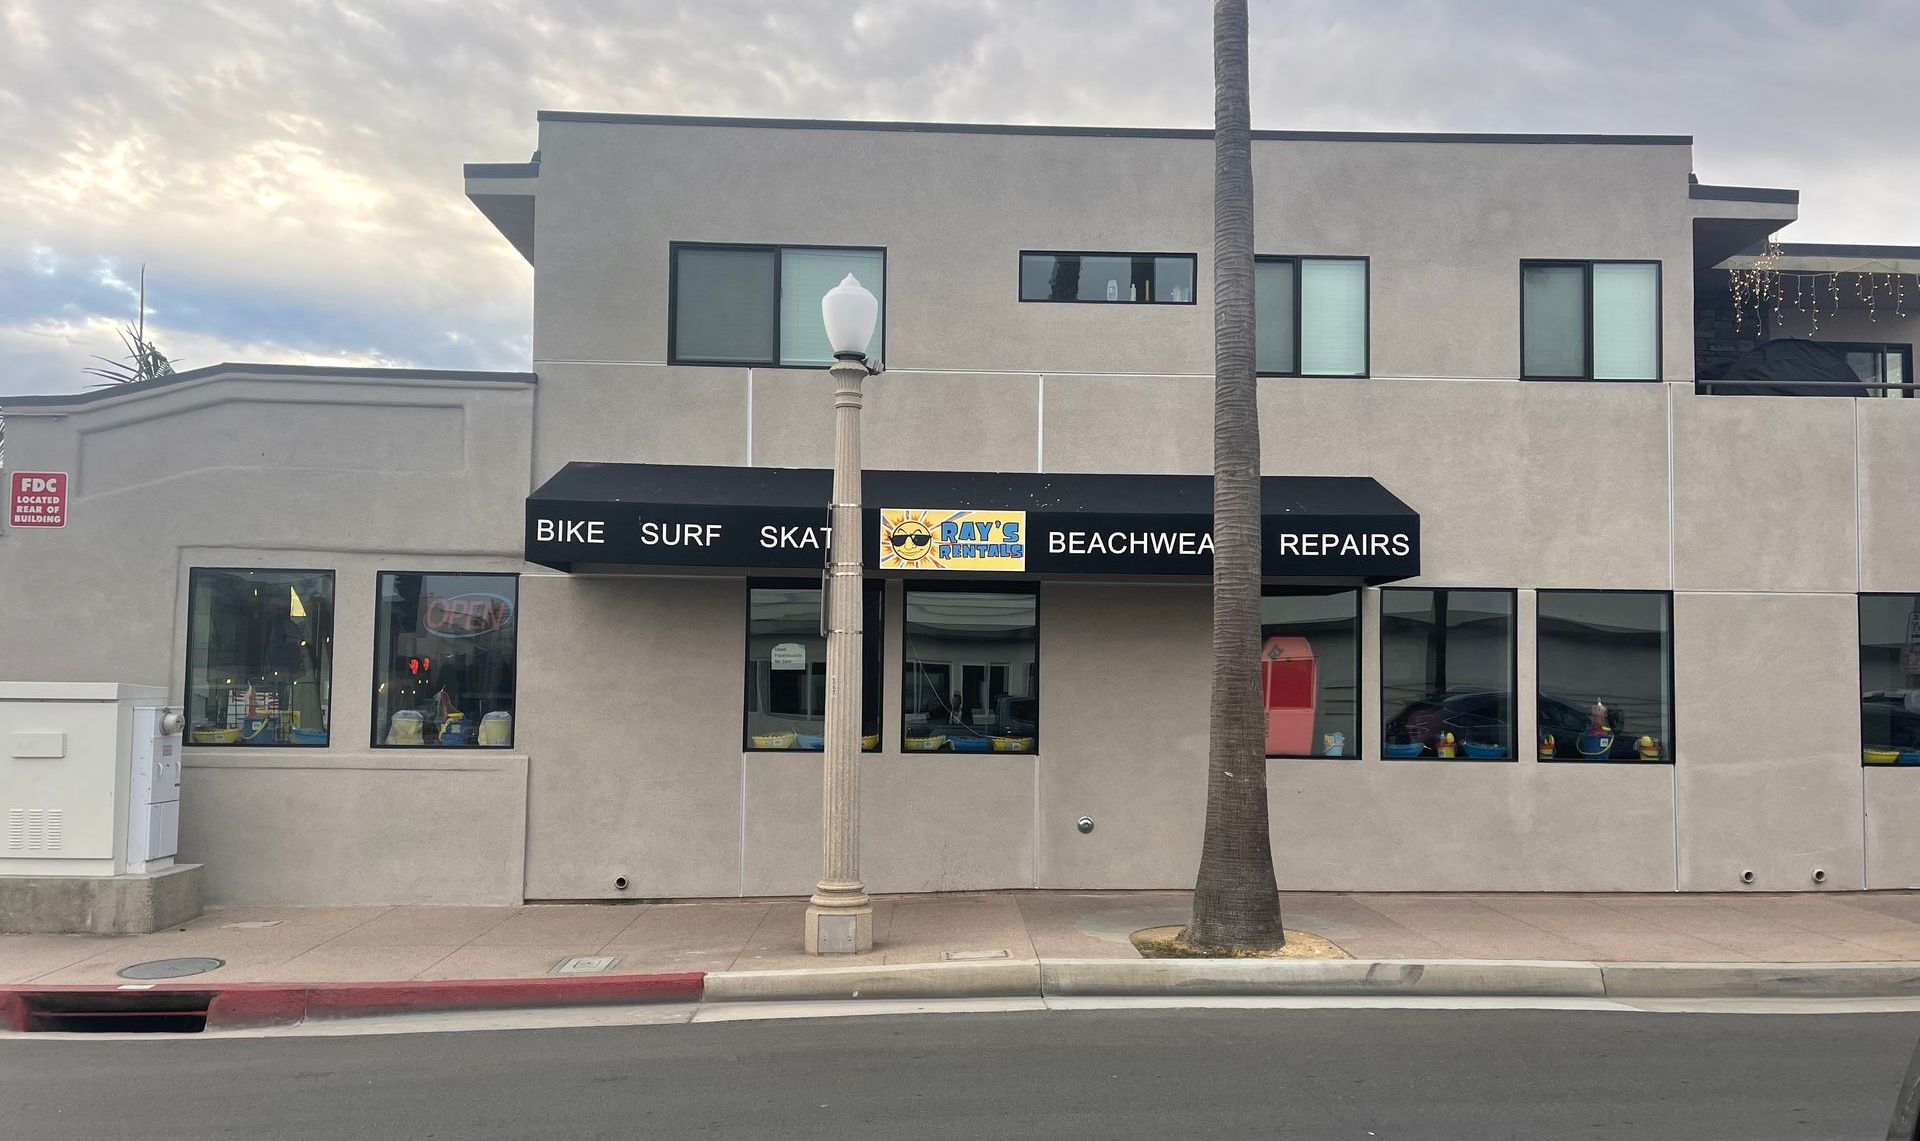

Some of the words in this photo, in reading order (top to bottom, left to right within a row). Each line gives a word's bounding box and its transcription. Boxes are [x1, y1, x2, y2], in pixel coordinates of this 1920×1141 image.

[21, 478, 57, 492] FDC
[17, 496, 60, 504] LOCATED
[16, 505, 42, 513] REAR
[47, 506, 60, 514] OF
[14, 515, 61, 523] BUILDING
[536, 519, 605, 544] BIKE
[640, 522, 722, 546] SURF
[759, 525, 832, 549] SKAT
[940, 520, 1020, 544] RAY'S
[1048, 531, 1215, 555] BEACHWEA
[1279, 533, 1411, 556] REPAIRS
[938, 544, 1024, 560] RENTALS
[427, 597, 506, 631] OPEN
